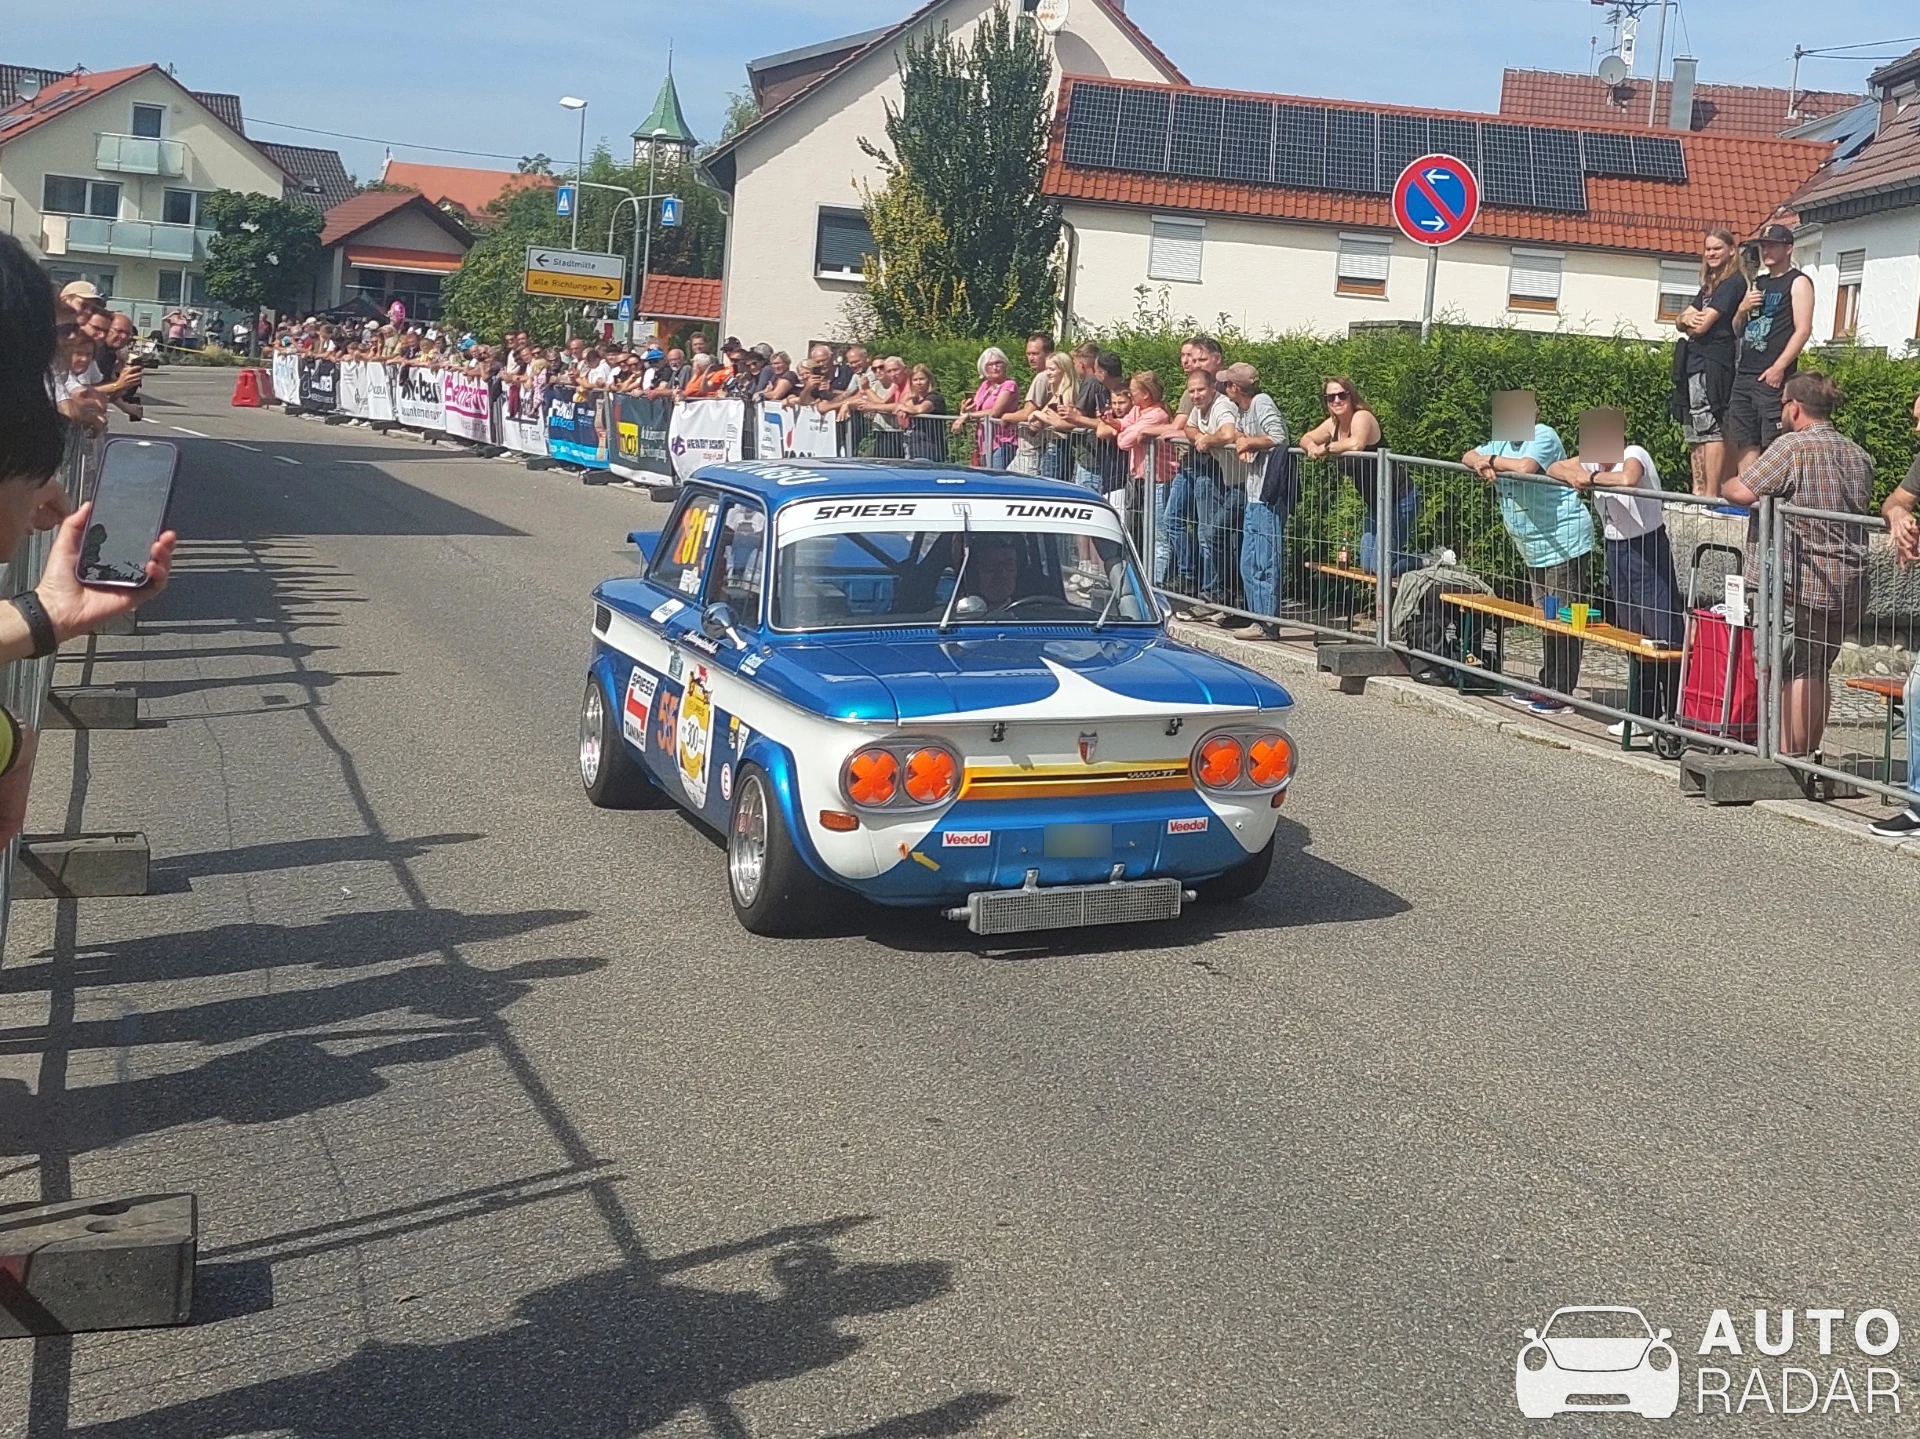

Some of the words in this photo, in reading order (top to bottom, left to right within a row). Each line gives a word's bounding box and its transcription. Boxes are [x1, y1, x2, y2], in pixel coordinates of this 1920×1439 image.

[552, 257, 596, 270] Stadtmitte
[533, 278, 549, 287] alle
[551, 279, 598, 292] Richtungen
[813, 503, 918, 520] SPIESS
[1005, 504, 1094, 521] TUNING
[630, 672, 656, 697] SPIESS
[624, 720, 645, 746] TUNING
[1169, 818, 1208, 833] Veedol
[944, 832, 990, 847] Veedol
